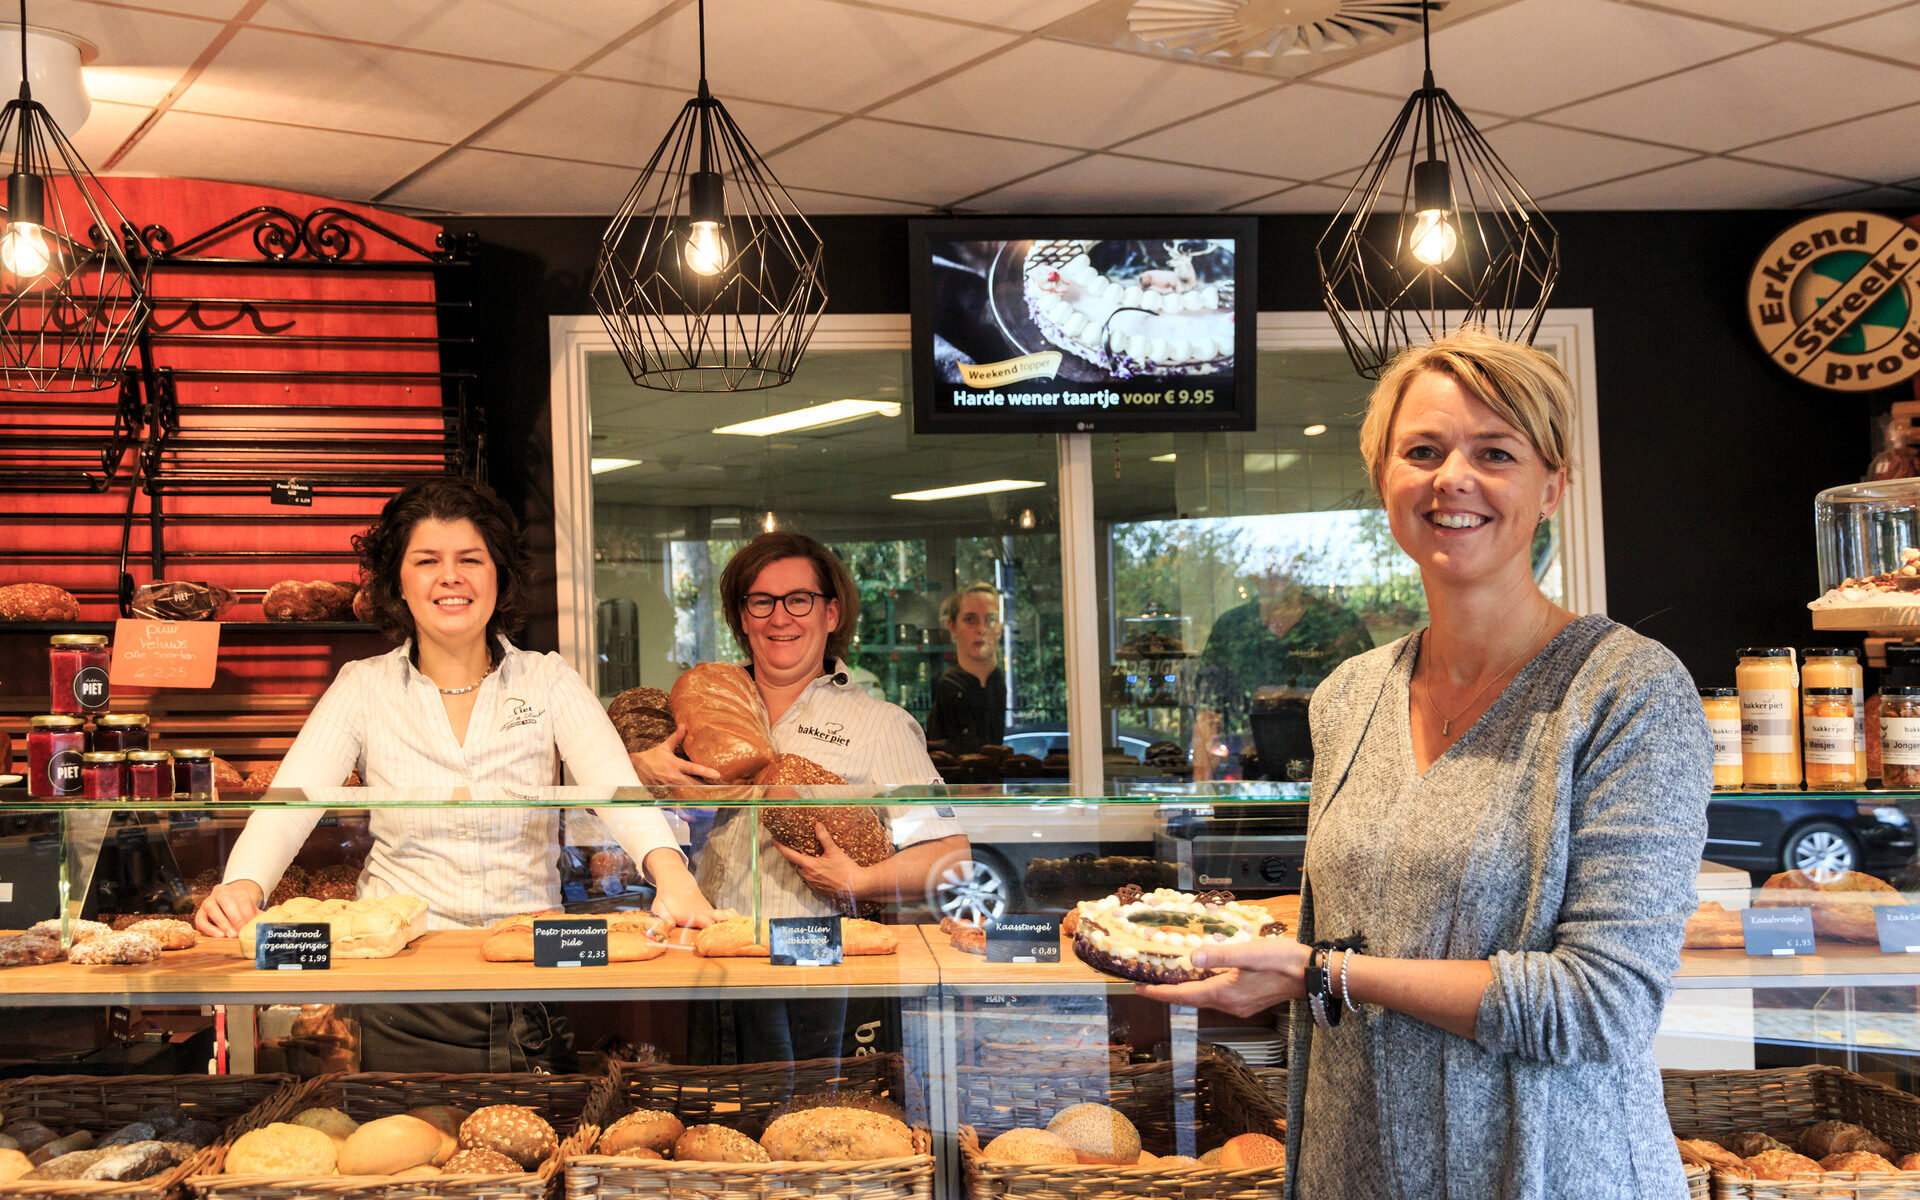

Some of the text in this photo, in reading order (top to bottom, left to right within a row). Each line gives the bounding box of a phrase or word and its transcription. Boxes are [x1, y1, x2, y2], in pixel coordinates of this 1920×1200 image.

[1758, 220, 1868, 326] Erkend
[1794, 253, 1907, 357] Streek
[968, 359, 1050, 380] Weekend topper
[953, 389, 1215, 409] Harde wener taartje voor € 9.95
[174, 592, 189, 602] PIET
[82, 682, 103, 695] PIET
[1743, 701, 1784, 711] bakker piet
[797, 724, 851, 747] bakker piet
[57, 766, 80, 780] PIET
[1750, 915, 1805, 926] Kaasbroodje
[1886, 914, 1910, 922] Kaas
[535, 926, 608, 938] Pesto pomodoro
[996, 922, 1052, 934] Kaasstengel
[267, 930, 322, 938] Breekbrood
[561, 938, 584, 949] pide
[580, 950, 606, 959] € 2,35
[1038, 947, 1057, 956] 0,89
[300, 954, 327, 963] € 1,99
